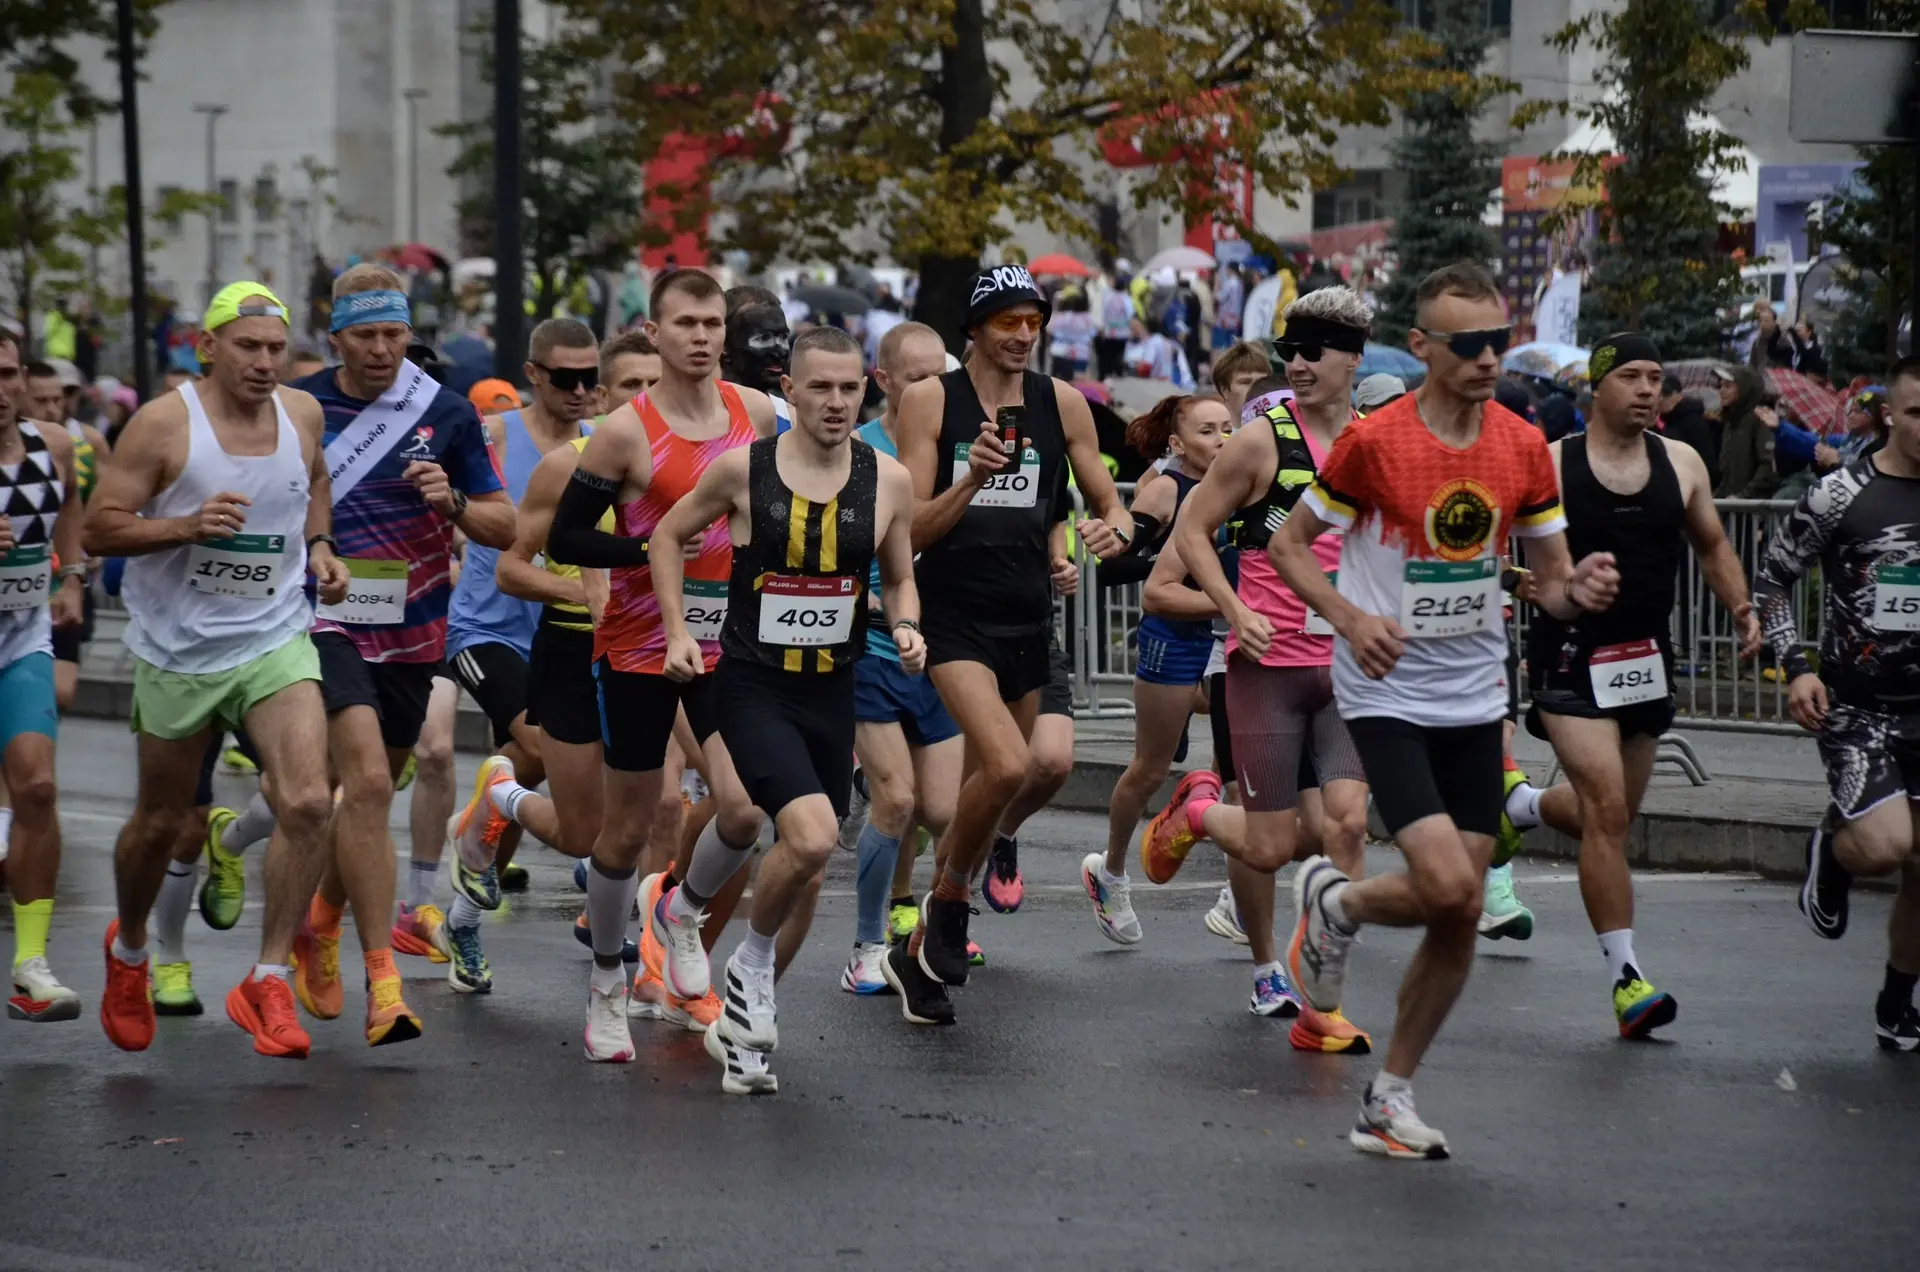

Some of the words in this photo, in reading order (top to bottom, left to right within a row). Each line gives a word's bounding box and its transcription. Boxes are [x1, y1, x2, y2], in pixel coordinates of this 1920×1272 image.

[354, 422, 388, 456] Кайф
[195, 560, 272, 582] 1798
[1411, 592, 1486, 617] 2124
[1882, 596, 1920, 614] 15
[684, 608, 729, 624] 24
[776, 609, 839, 627] 403
[1608, 667, 1653, 688] 491
